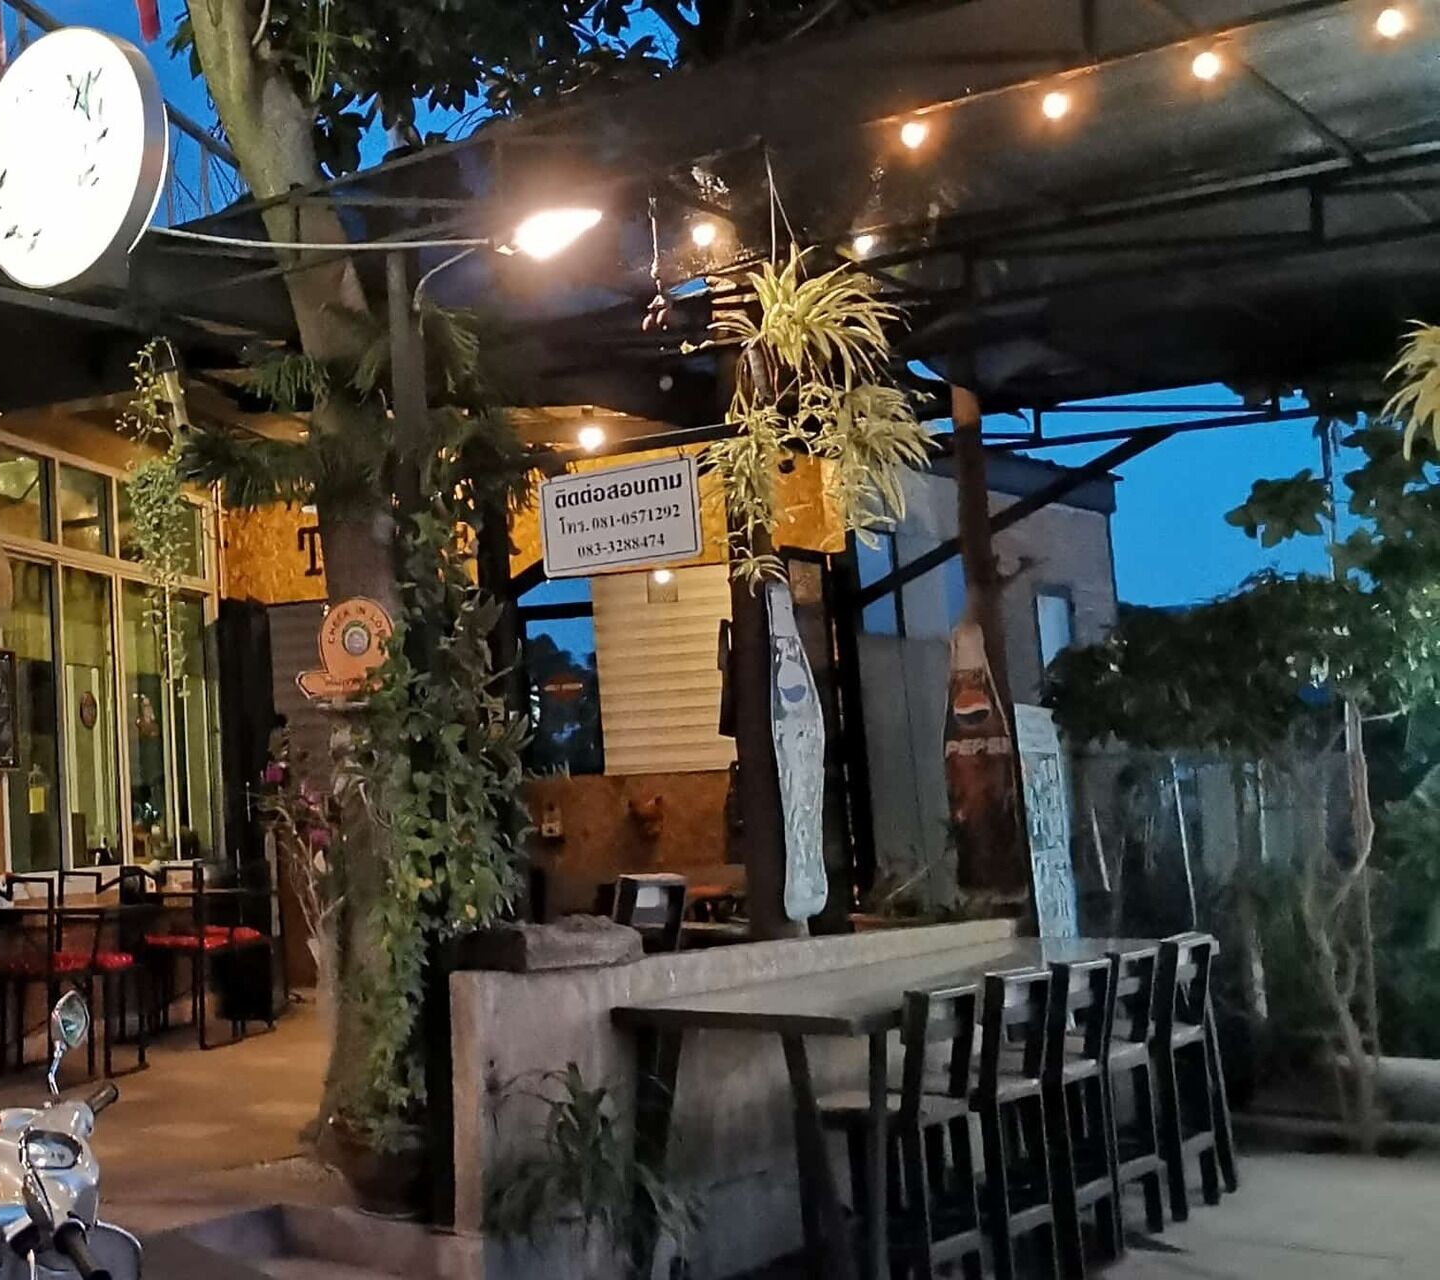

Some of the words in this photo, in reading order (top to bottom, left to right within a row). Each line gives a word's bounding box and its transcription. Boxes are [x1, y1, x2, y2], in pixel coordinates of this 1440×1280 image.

[554, 472, 683, 509] ติดต่อสอบถาม
[577, 532, 665, 558] 083-3288474
